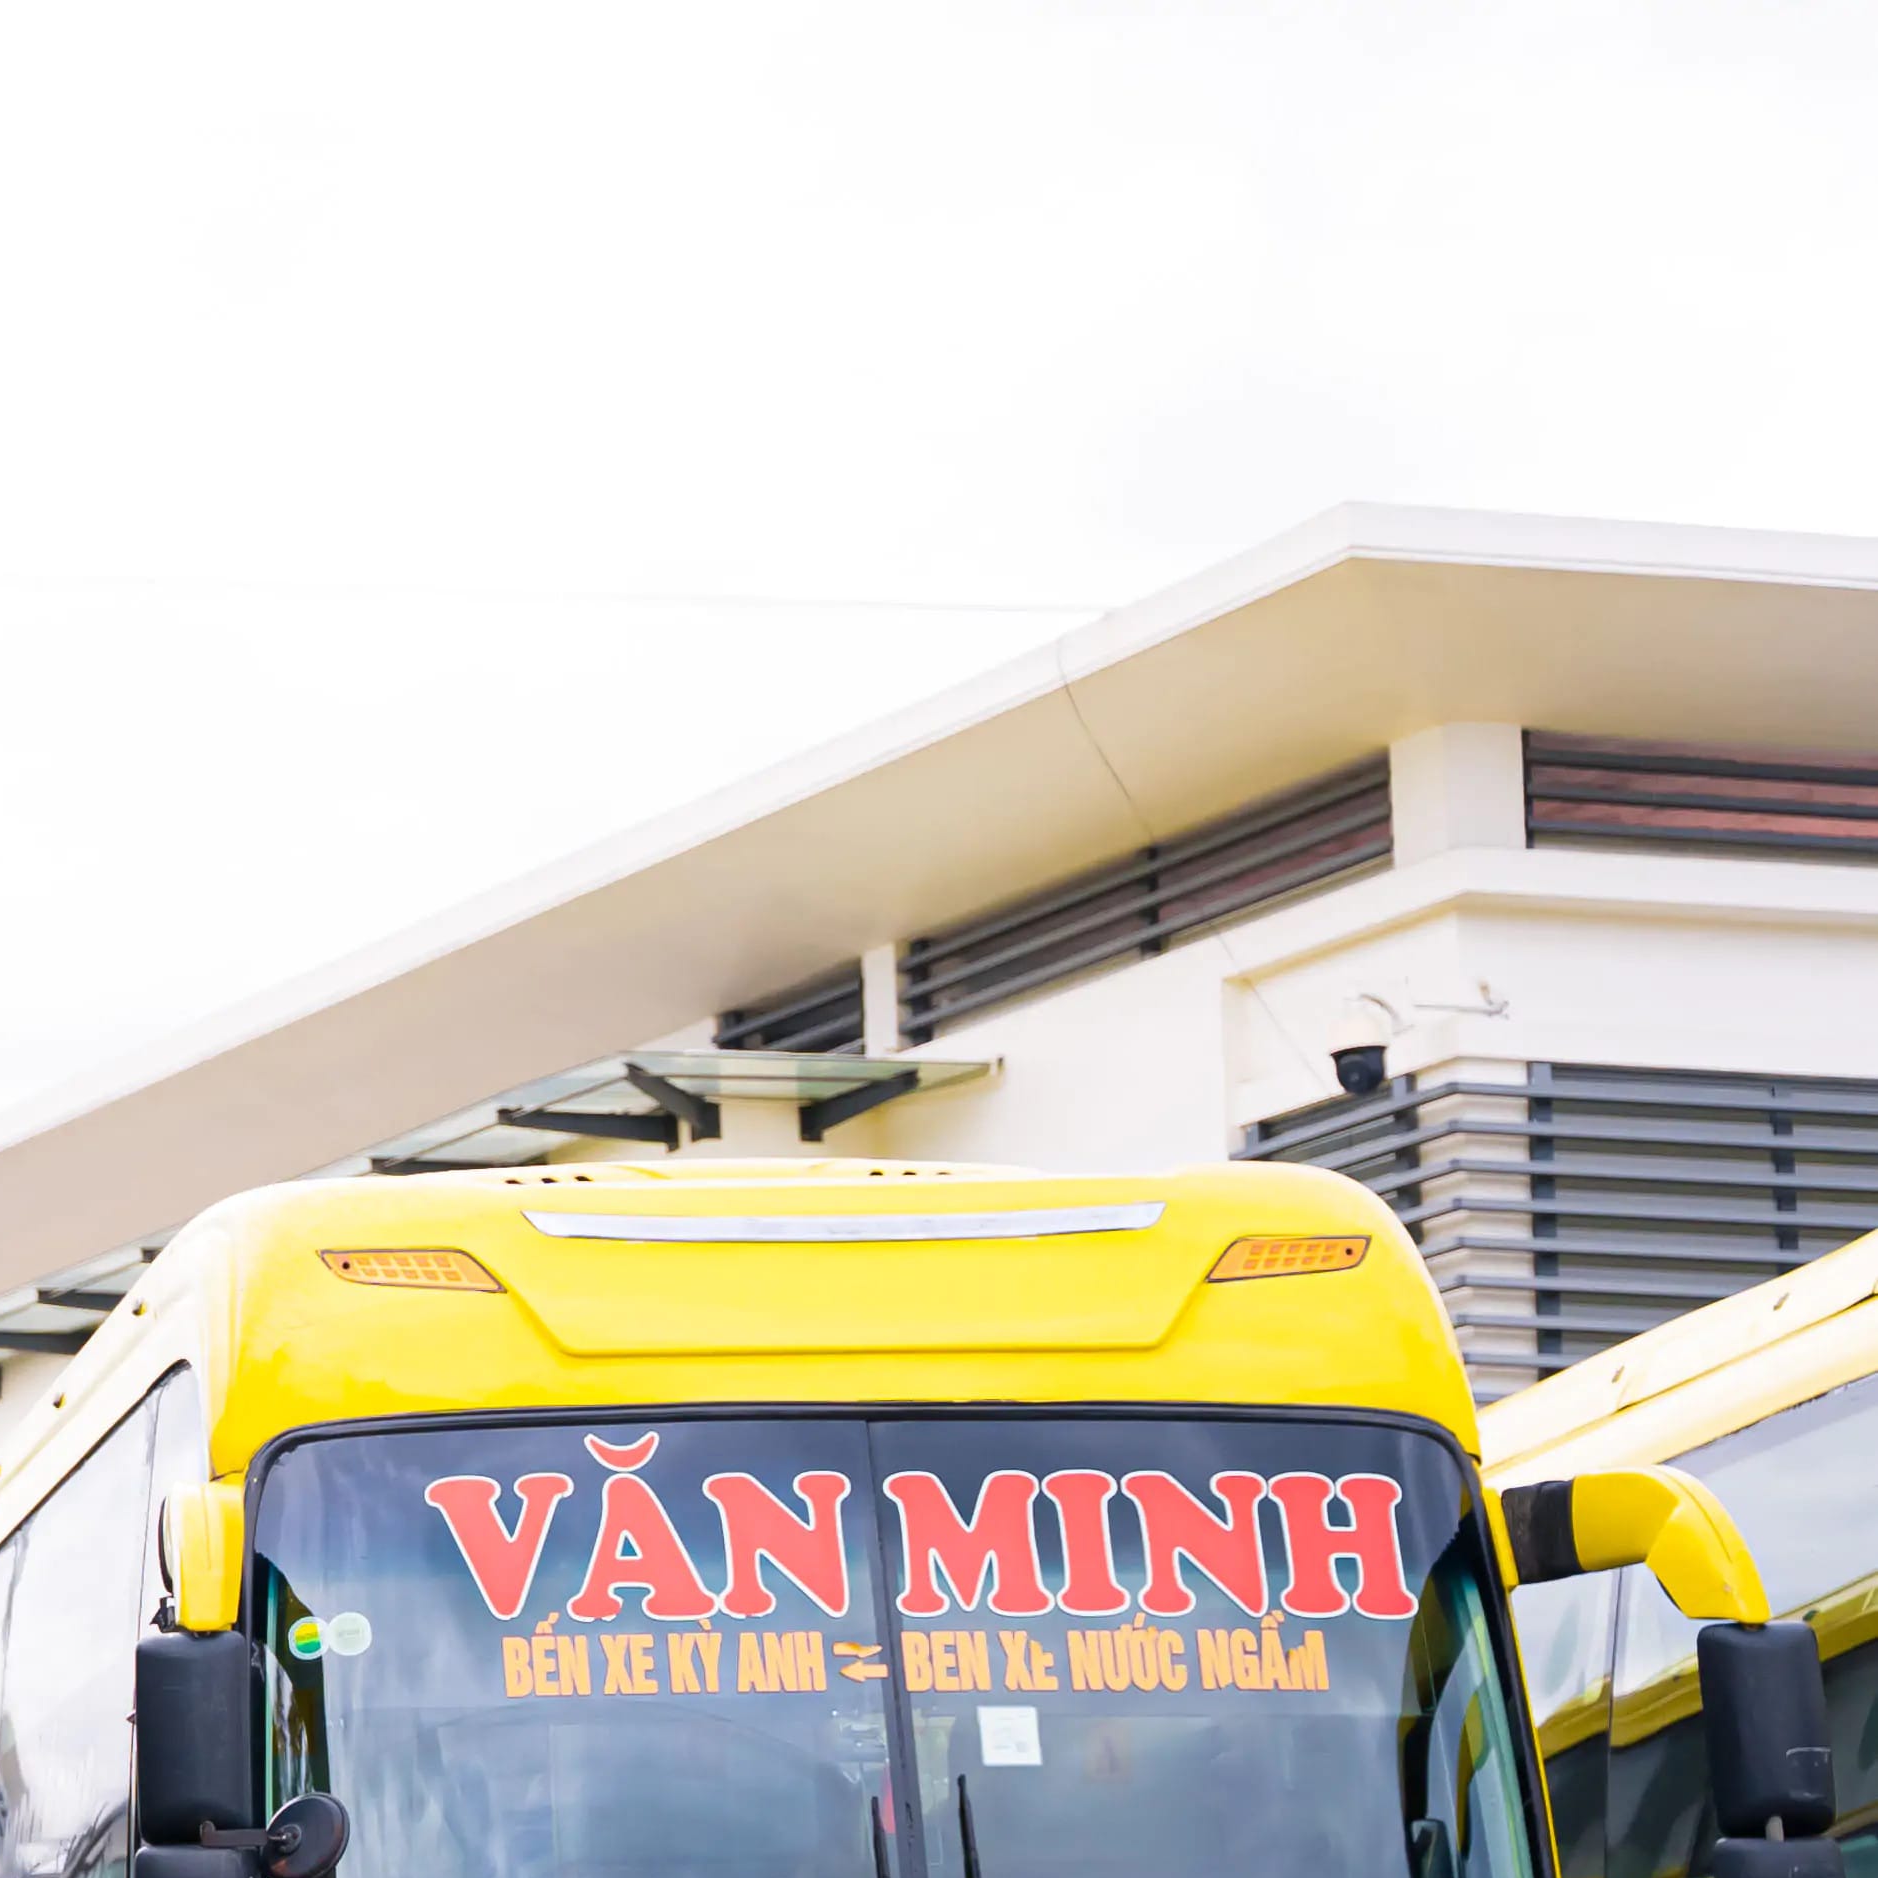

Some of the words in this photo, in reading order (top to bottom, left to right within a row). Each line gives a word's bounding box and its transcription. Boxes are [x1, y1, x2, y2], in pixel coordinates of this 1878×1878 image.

[424, 1430, 851, 1622] VĂN
[882, 1469, 1419, 1621] MINH
[501, 1611, 592, 1698] BẾN
[599, 1633, 659, 1695] XE
[667, 1618, 722, 1694] KỲ
[737, 1631, 827, 1692] ANH
[1067, 1612, 1188, 1692] NƯỚC
